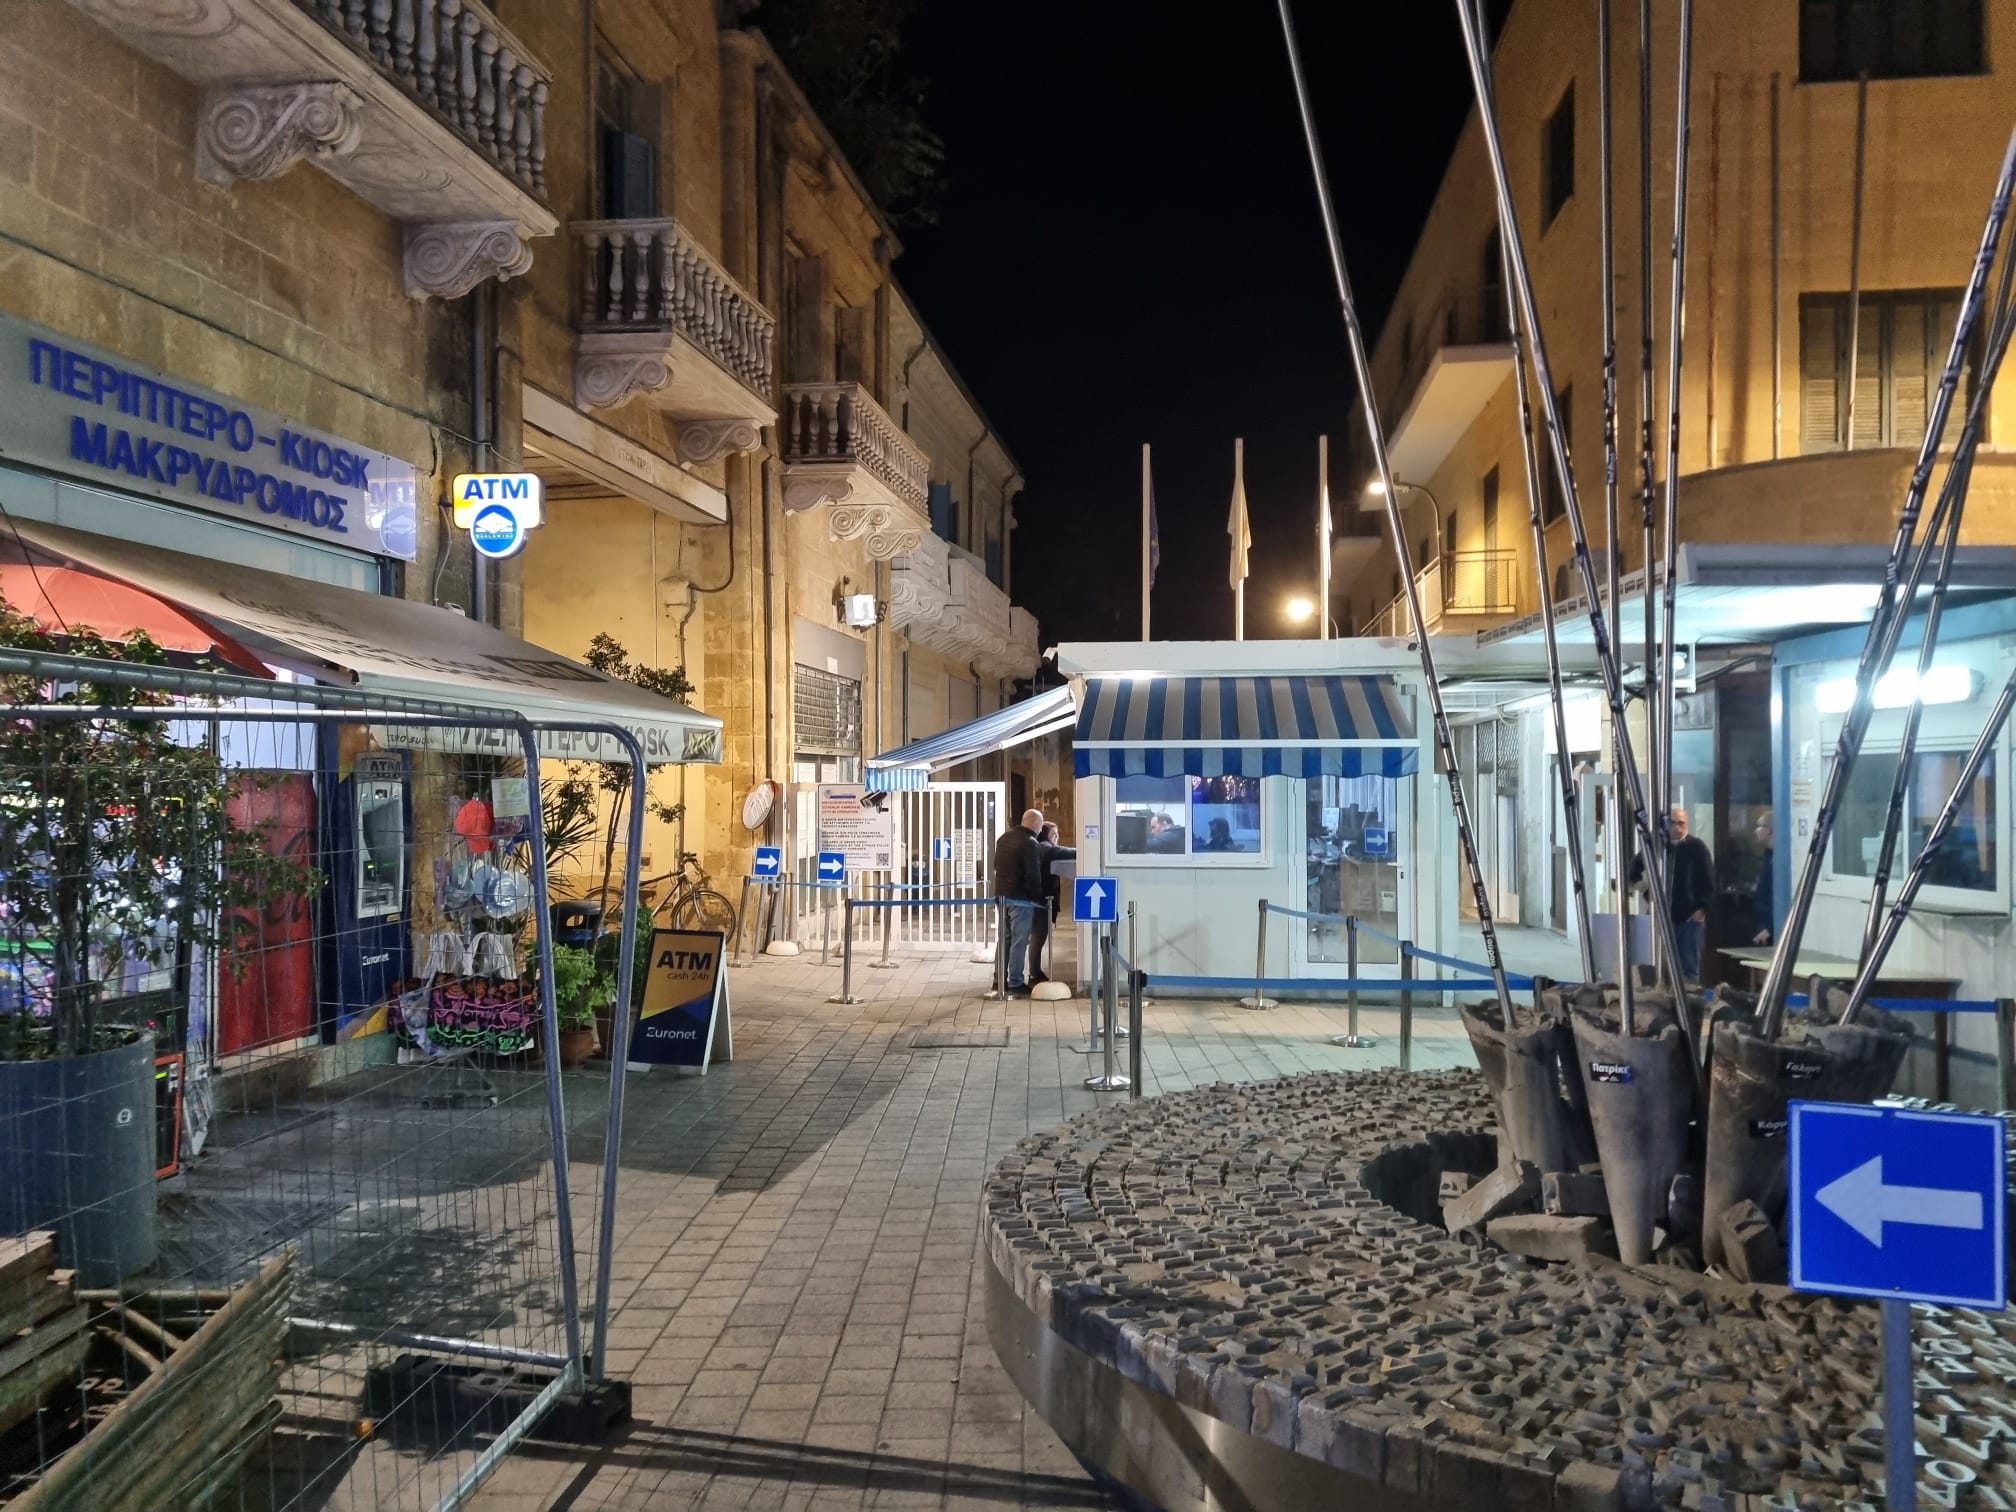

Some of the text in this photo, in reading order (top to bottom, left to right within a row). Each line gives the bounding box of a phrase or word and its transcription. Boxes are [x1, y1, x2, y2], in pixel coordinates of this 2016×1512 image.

[29, 337, 255, 452] ΠΕΡΙΠΤΕΡΟ
[280, 428, 371, 491] KIOSK
[70, 415, 348, 533] ΜΑΚΡΥΔΡΟΜΟΣ
[463, 478, 529, 501] ATM
[656, 950, 713, 971] ATM
[667, 970, 710, 982] cash 24h
[646, 1026, 697, 1040] Euronet
